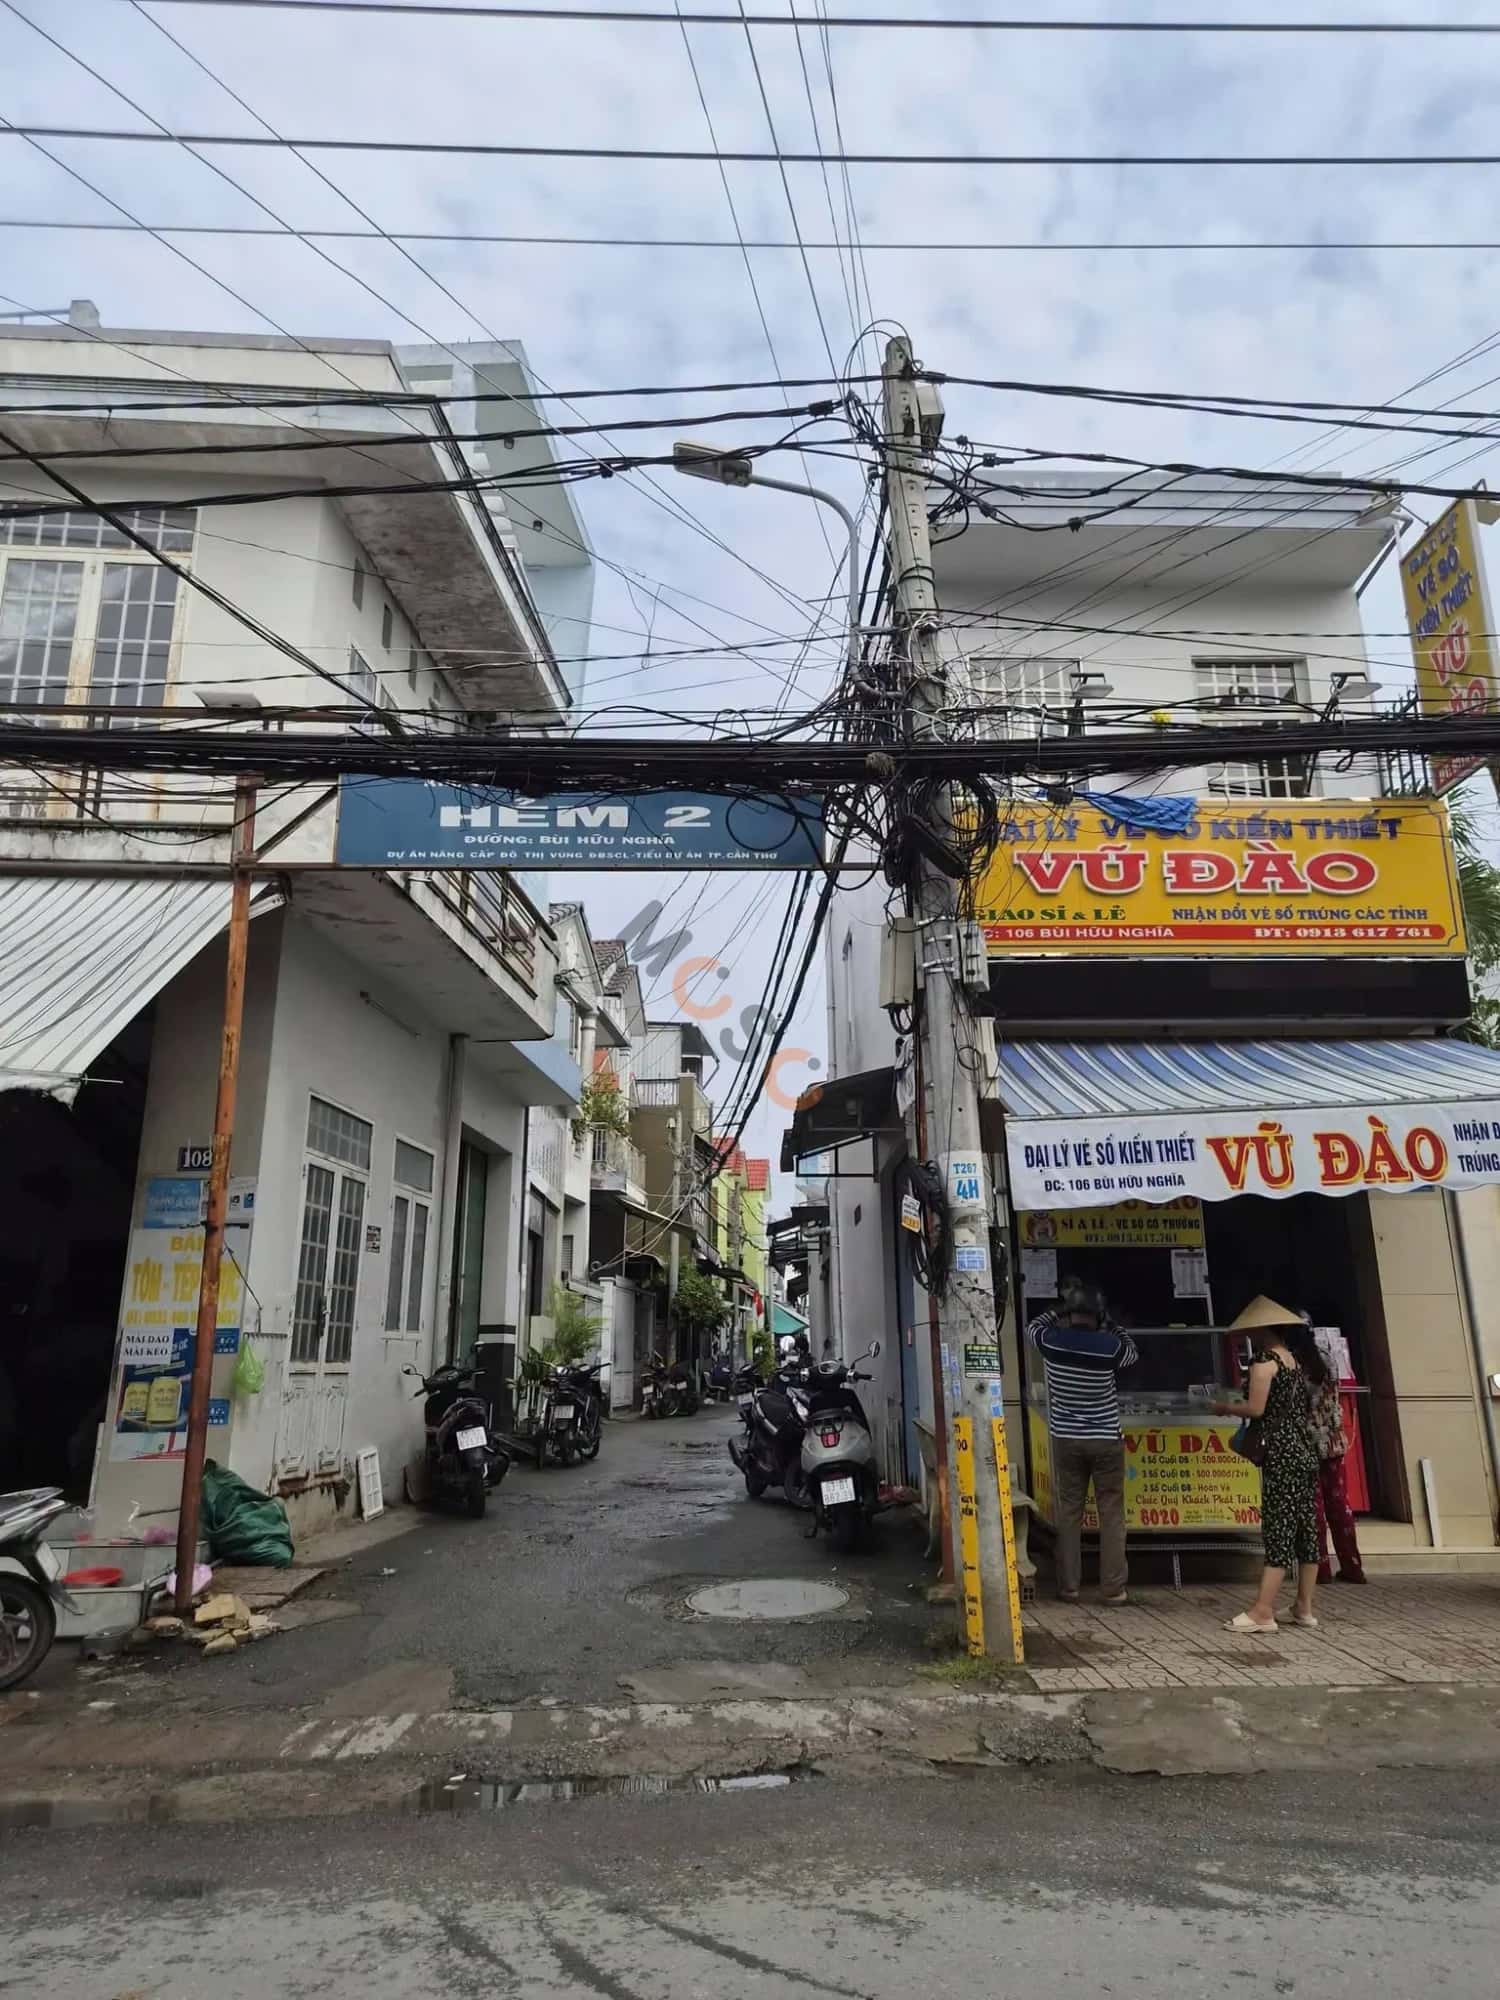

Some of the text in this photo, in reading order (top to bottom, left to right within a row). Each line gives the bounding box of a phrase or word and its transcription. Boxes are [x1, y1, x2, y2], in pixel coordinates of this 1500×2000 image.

[1429, 618, 1469, 687] VŨ
[664, 806, 711, 828] 2
[1209, 808, 1294, 841] KIẾN
[1300, 808, 1402, 841] THIẾT
[540, 834, 568, 845] BÙI
[577, 833, 614, 845] HỮU
[622, 833, 675, 845] NGHĨA
[1014, 840, 1378, 897] VŨ ĐÀO
[1072, 911, 1087, 922] &
[1173, 906, 1216, 922] NHẬN
[1220, 903, 1248, 921] ĐỔI
[1250, 906, 1271, 920] VÉ
[1275, 904, 1293, 920] SỐ
[1297, 906, 1351, 921] TRÚNG
[1355, 906, 1385, 920] CÁC
[982, 926, 1175, 939] C: 106 BÙI HỮU NGHĨA
[1253, 927, 1433, 938] ĐT: 0913 617 761
[1453, 1120, 1490, 1144] NHẬN
[183, 1150, 213, 1168] 108
[1024, 1130, 1196, 1176] ĐẠI LÝ VÉ SỐ KIẾN THIẾT
[1206, 1115, 1448, 1192] VŨ ĐÀO
[1457, 1149, 1500, 1173] TRÚNG
[956, 1178, 980, 1201] 4H
[1044, 1173, 1186, 1193] ĐC: 106 BÙI HỮU NGHĨA
